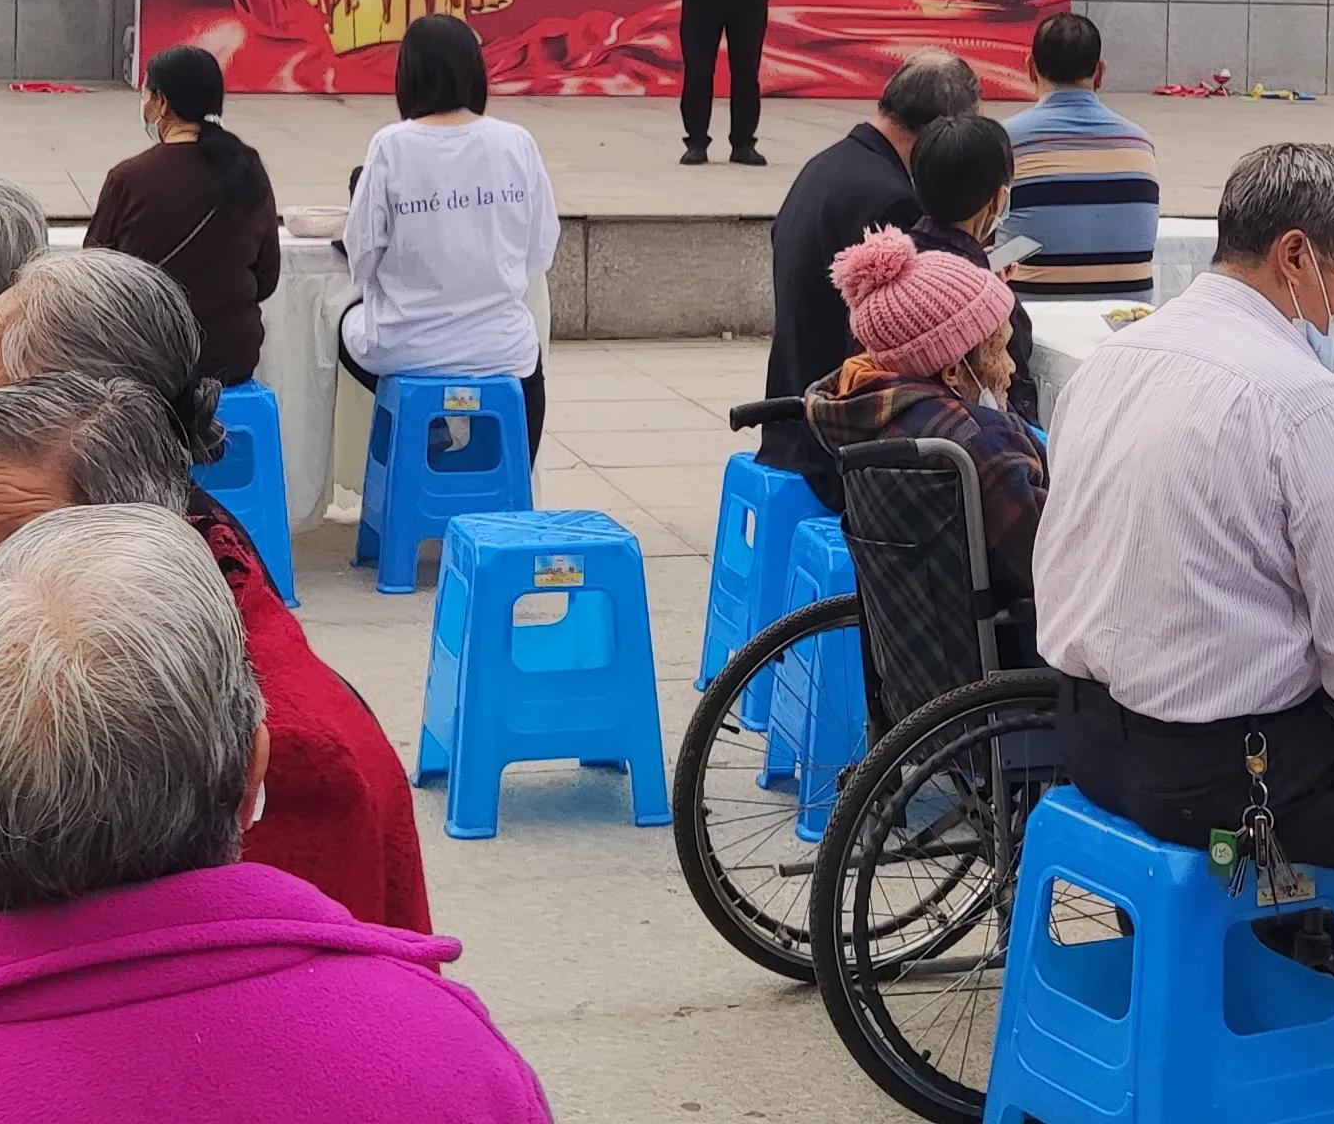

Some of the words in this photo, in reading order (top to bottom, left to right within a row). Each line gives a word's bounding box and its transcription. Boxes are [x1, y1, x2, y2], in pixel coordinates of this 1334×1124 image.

[447, 190, 469, 210] de
[477, 186, 494, 206] la
[501, 183, 524, 203] vie
